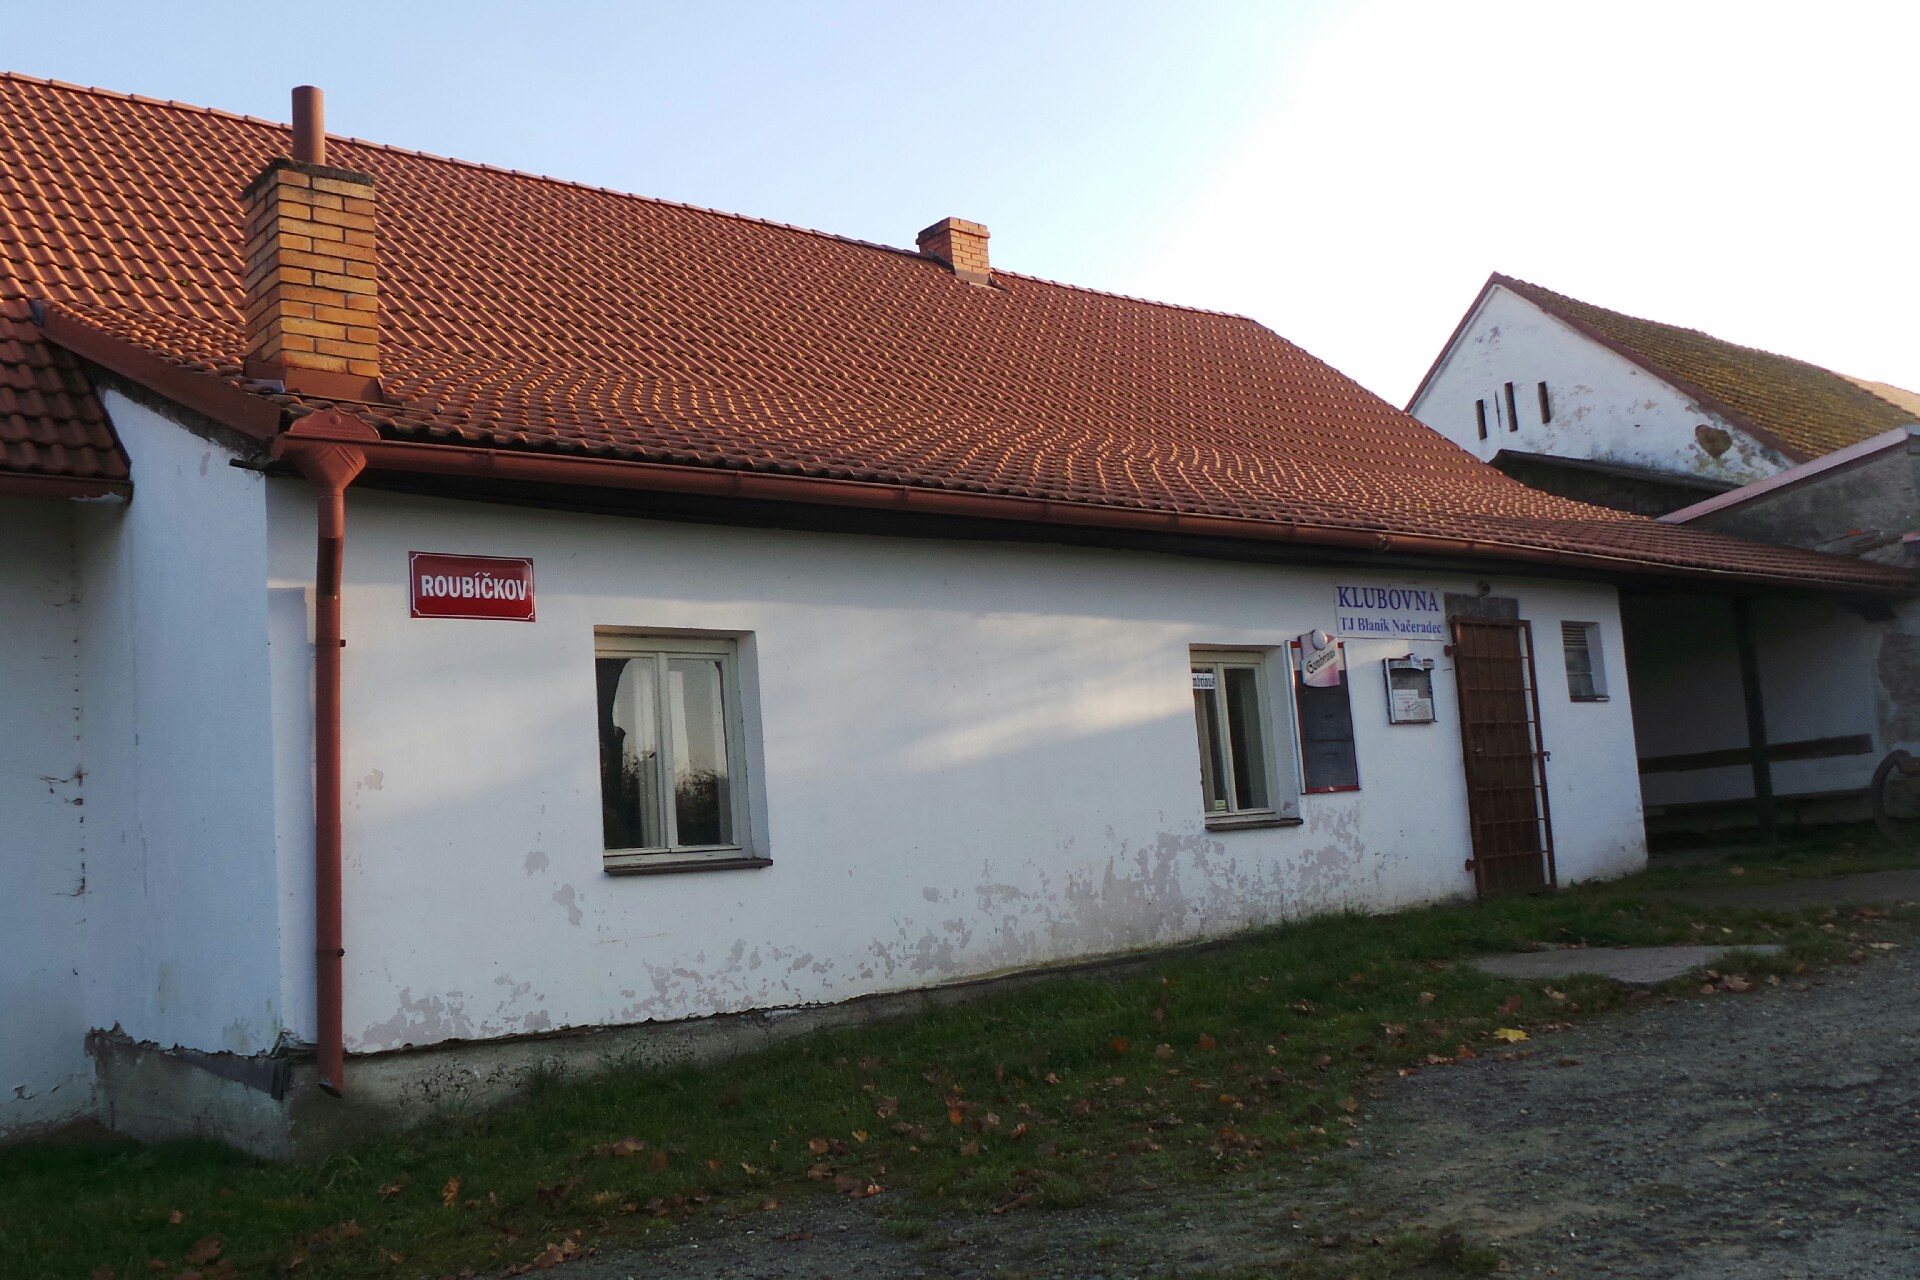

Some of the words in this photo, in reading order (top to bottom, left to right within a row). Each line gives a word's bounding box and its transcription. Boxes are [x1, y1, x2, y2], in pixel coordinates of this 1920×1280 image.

[421, 571, 527, 601] ROUBÍČKOV
[1336, 586, 1440, 612] KLUBOVNA
[1340, 617, 1354, 631] TJ
[1358, 617, 1390, 632] Blaník
[1392, 619, 1442, 634] Načeradec
[1306, 649, 1336, 674] Gambrinus
